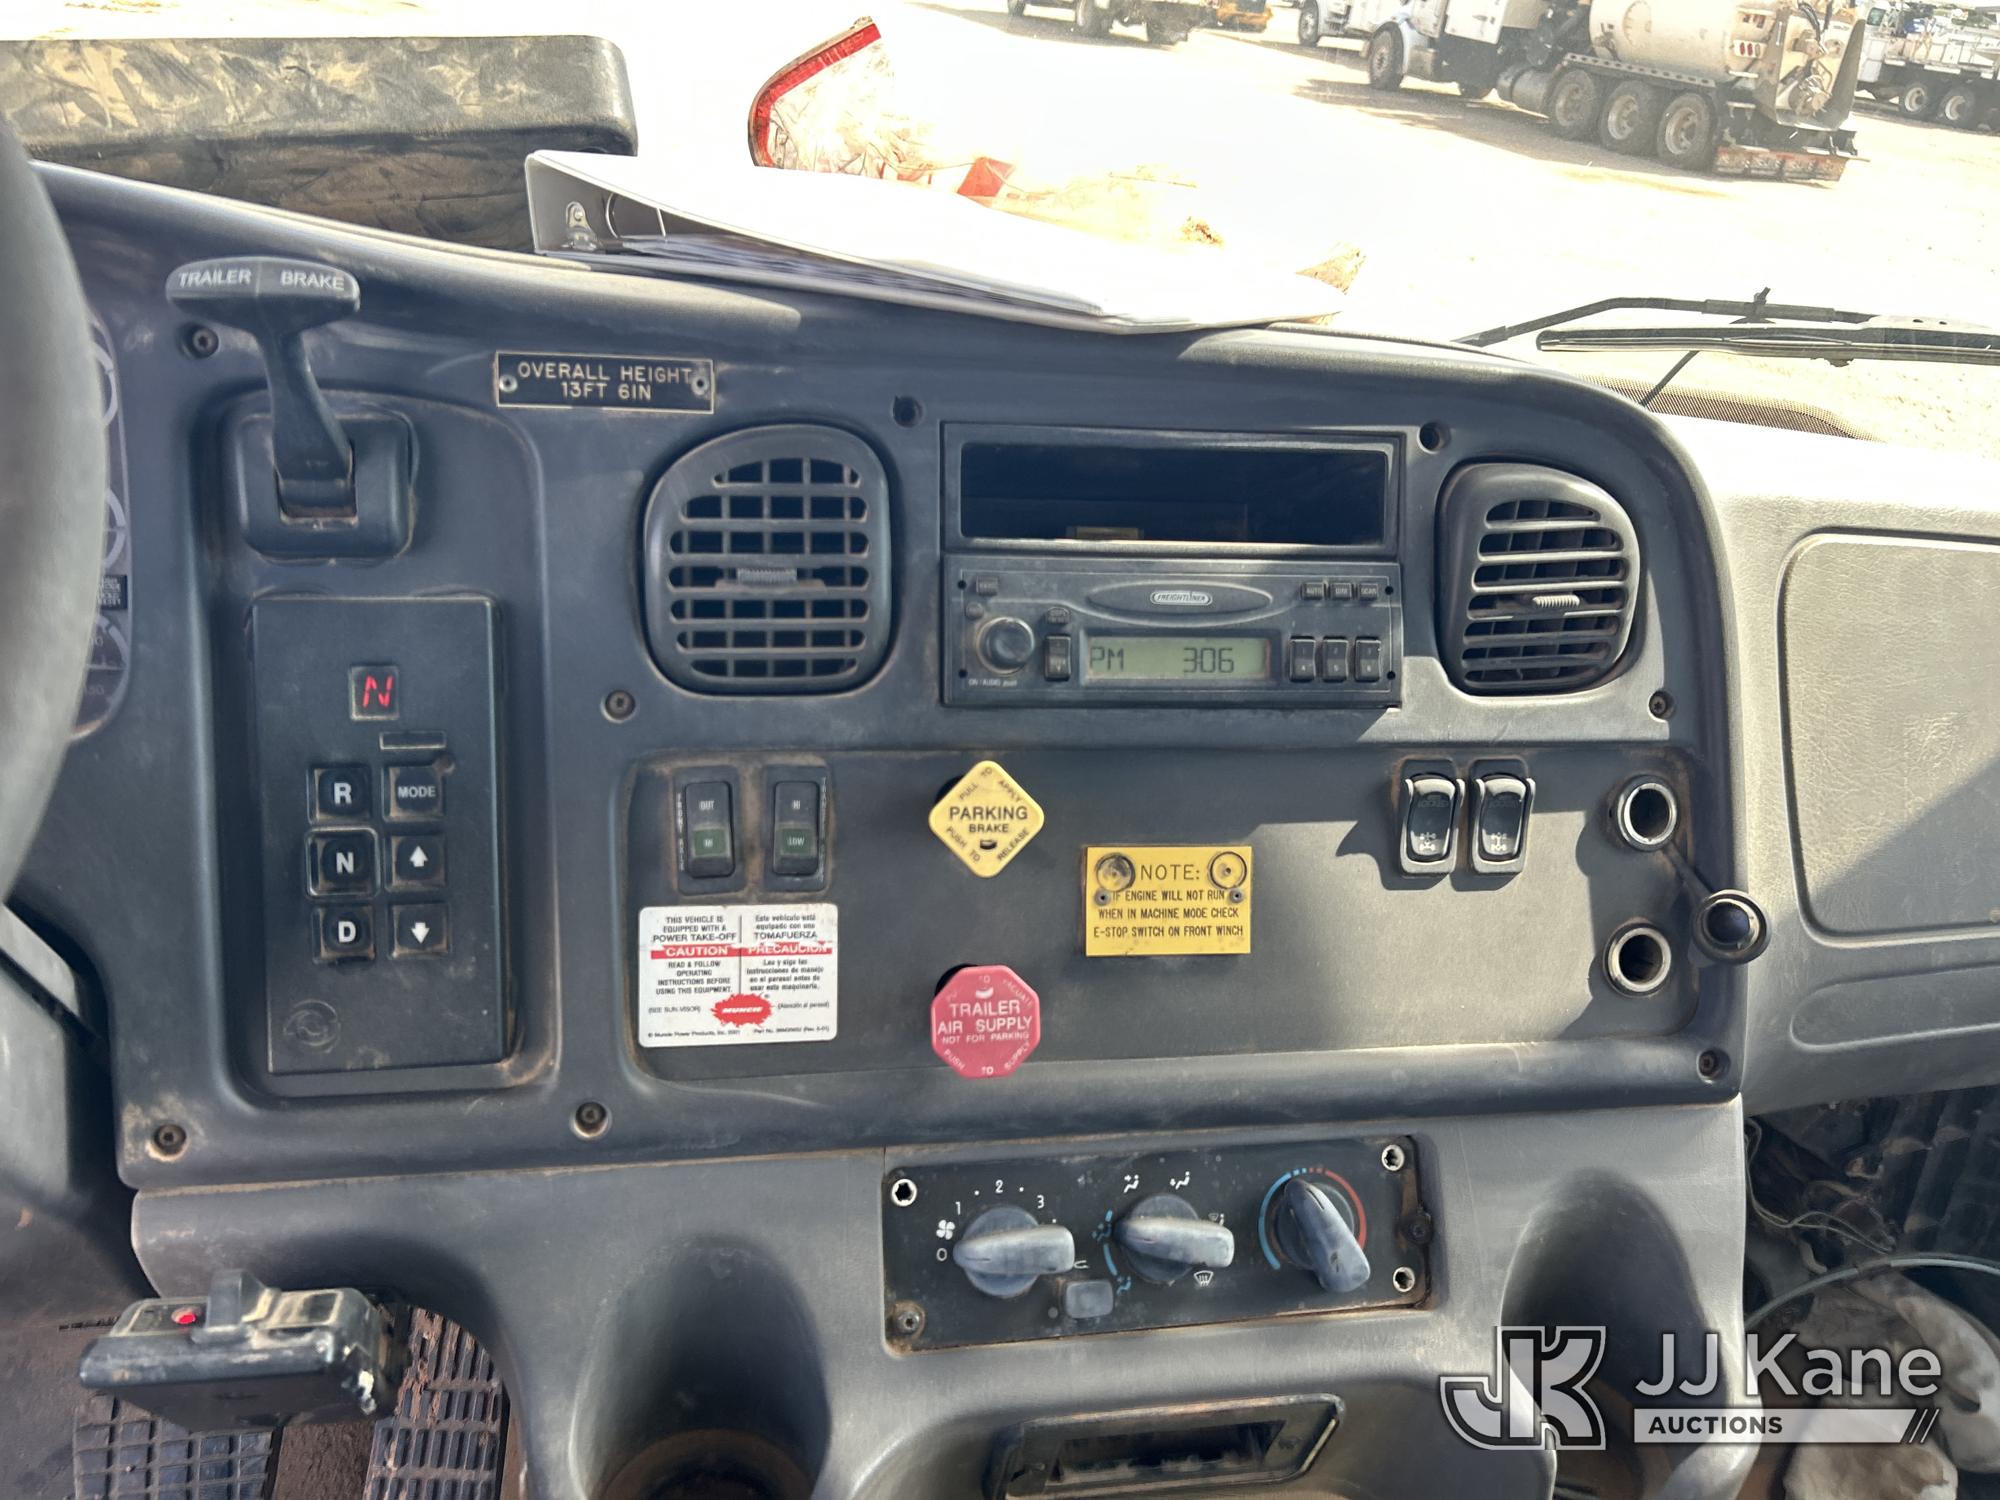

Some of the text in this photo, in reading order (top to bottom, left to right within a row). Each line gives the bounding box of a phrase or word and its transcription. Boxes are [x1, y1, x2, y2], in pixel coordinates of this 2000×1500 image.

[178, 268, 344, 291] TRAILER BRAKE
[518, 361, 692, 384] OVERALL HEIGHT
[562, 382, 652, 400] 13FT 6IN
[1156, 593, 1208, 602] FREIGHTLINER
[1090, 646, 1124, 671] PM
[363, 675, 394, 708] N
[334, 782, 352, 804] R
[398, 786, 436, 798] MODE
[959, 783, 979, 801] PULL
[998, 780, 1023, 802] APPLY
[700, 800, 714, 811] OUT
[792, 800, 800, 811] HI
[950, 806, 1028, 820] PARKING
[969, 824, 1009, 833] BRAKE
[788, 836, 805, 846] LOW
[946, 826, 967, 848] PUSH
[997, 828, 1029, 860] RELEASE
[336, 852, 354, 873] N
[969, 850, 981, 862] TO
[1140, 864, 1200, 880] NOTE:
[1112, 890, 1225, 901] IF ENGINE WILL NOT RUN
[685, 916, 714, 924] VEHICLE
[1099, 908, 1239, 919] WHEN IN MACHINE MODE CHECK
[338, 921, 356, 943] D
[663, 925, 698, 934] EQUIPPED
[756, 923, 787, 932] equipado
[1094, 925, 1244, 938] E-STOP SWITCH ON FRONT WINCH
[691, 933, 736, 942] TAKE-OFF
[754, 931, 817, 940] TOMAFUERZA
[666, 946, 728, 957] CAUTION
[950, 1000, 1020, 1018] TRAILER
[938, 1016, 1032, 1034] AIR SUPPLY
[942, 1032, 1030, 1044] NOT FOR PARKING
[944, 1049, 965, 1070] PUSH
[1004, 1042, 1030, 1070] SUPPLY
[982, 1066, 994, 1075] TO
[995, 1180, 1004, 1194] 2
[955, 1201, 961, 1215] 1
[1037, 1195, 1044, 1208] 3
